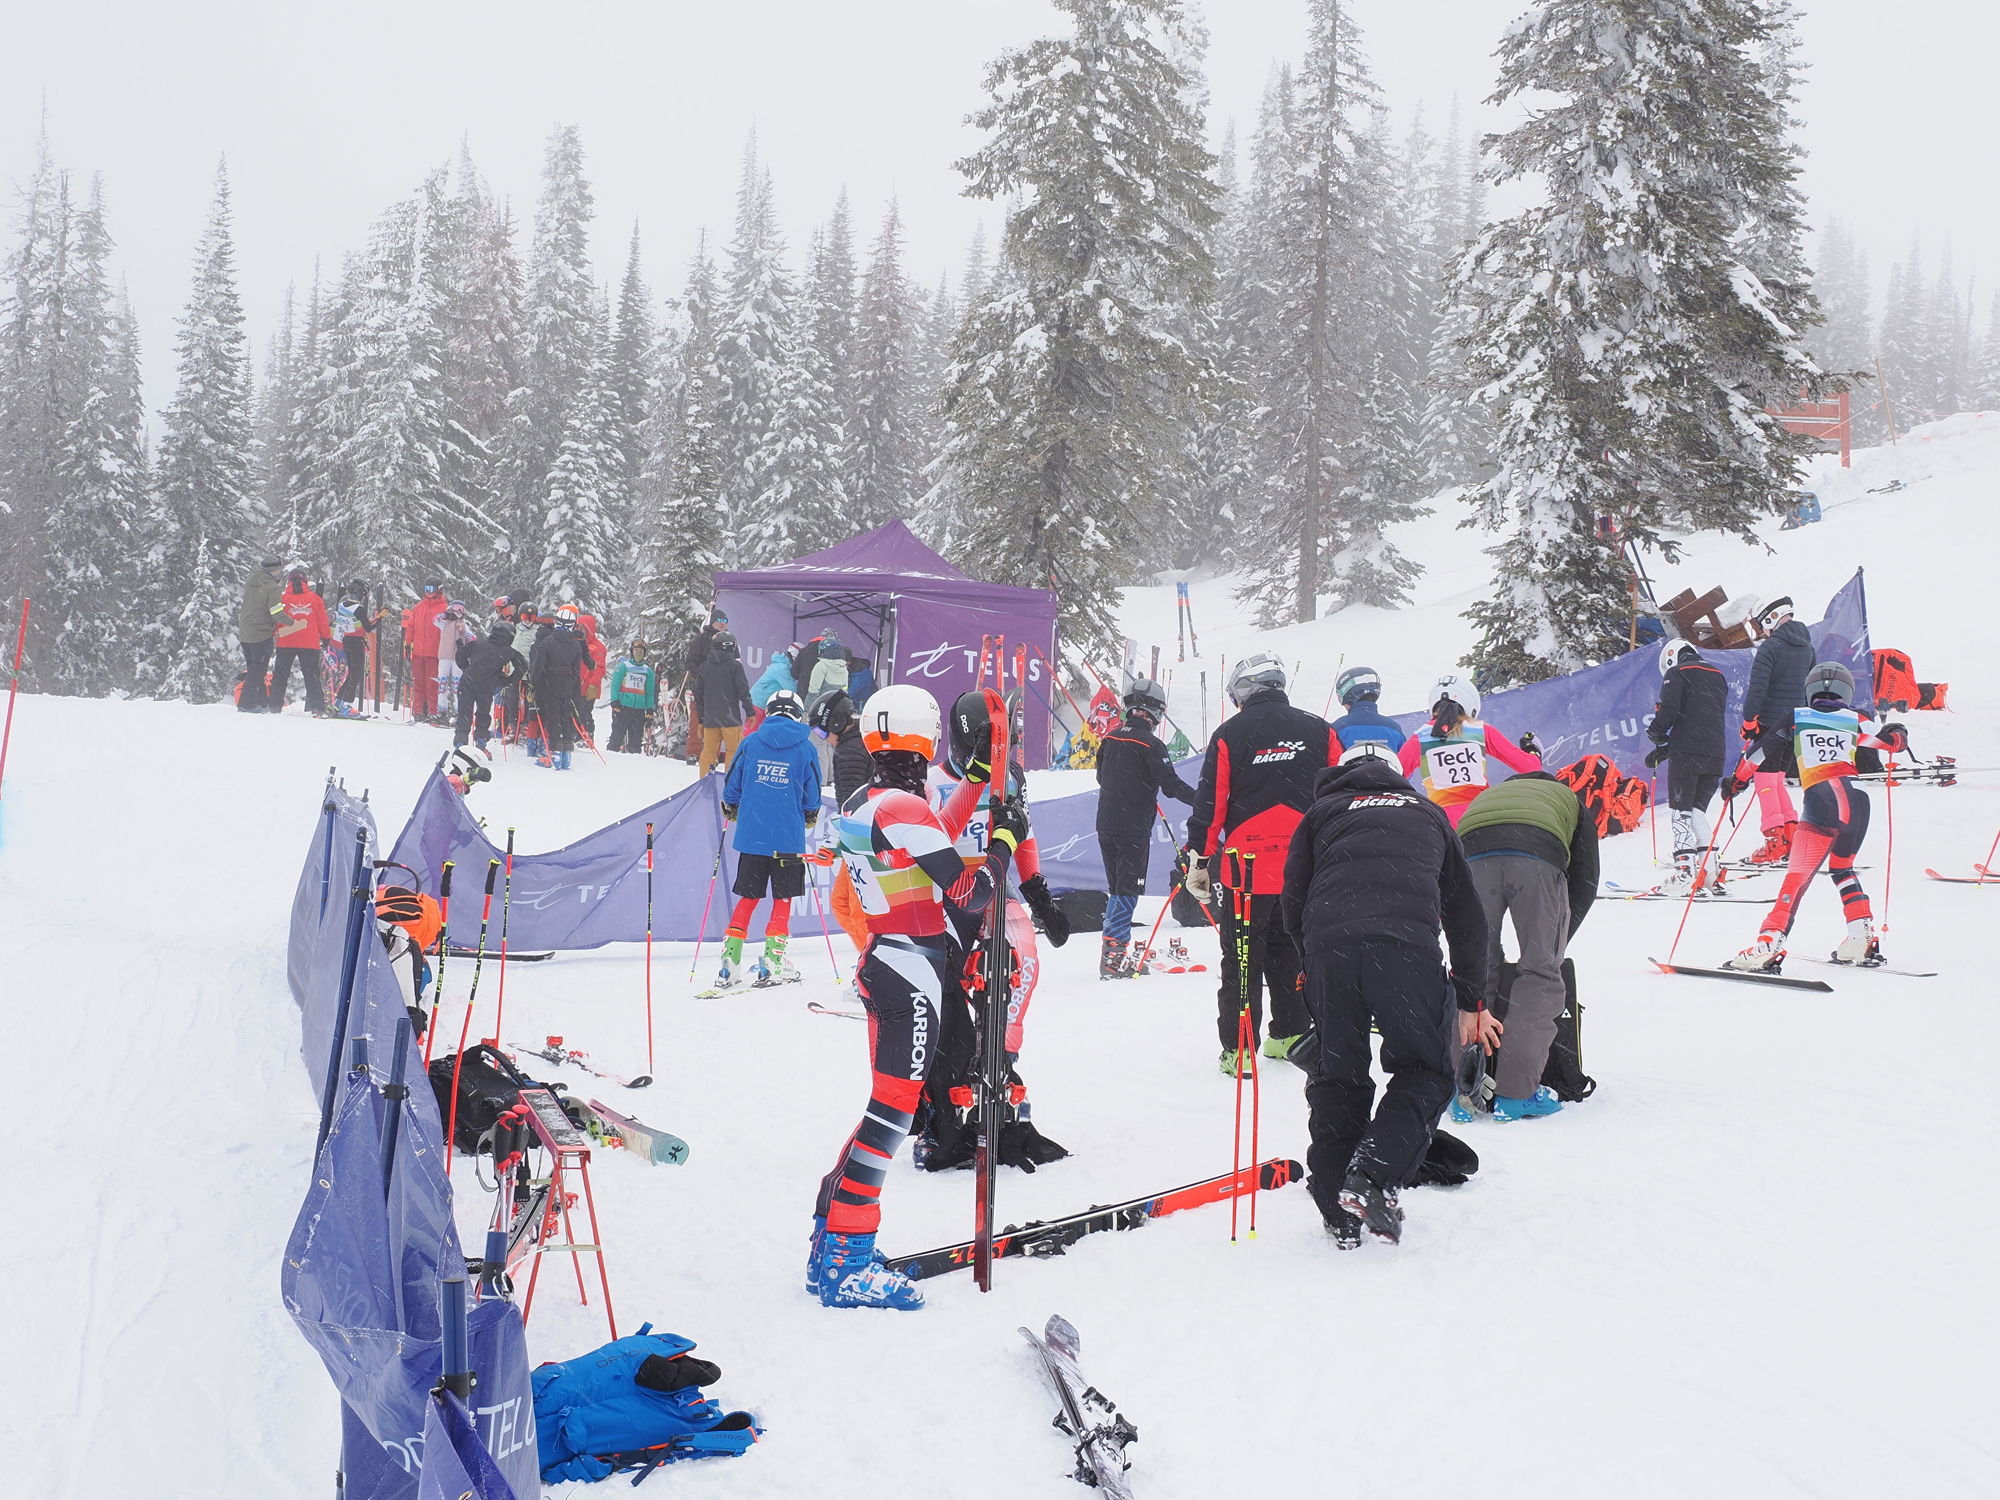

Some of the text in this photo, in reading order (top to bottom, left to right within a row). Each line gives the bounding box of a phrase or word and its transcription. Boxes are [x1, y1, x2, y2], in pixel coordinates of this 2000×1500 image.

[964, 649, 1040, 682] TES
[1806, 733, 1845, 750] Teck
[1252, 751, 1297, 764] RACERS
[1433, 747, 1478, 767] Teck
[1818, 749, 1838, 762] 22
[756, 764, 788, 777] TYEE
[1449, 766, 1471, 783] 23
[770, 776, 789, 784] CLUB
[1347, 798, 1406, 810] RACERS
[909, 990, 928, 1081] KARBON
[838, 1287, 872, 1303] LANGE
